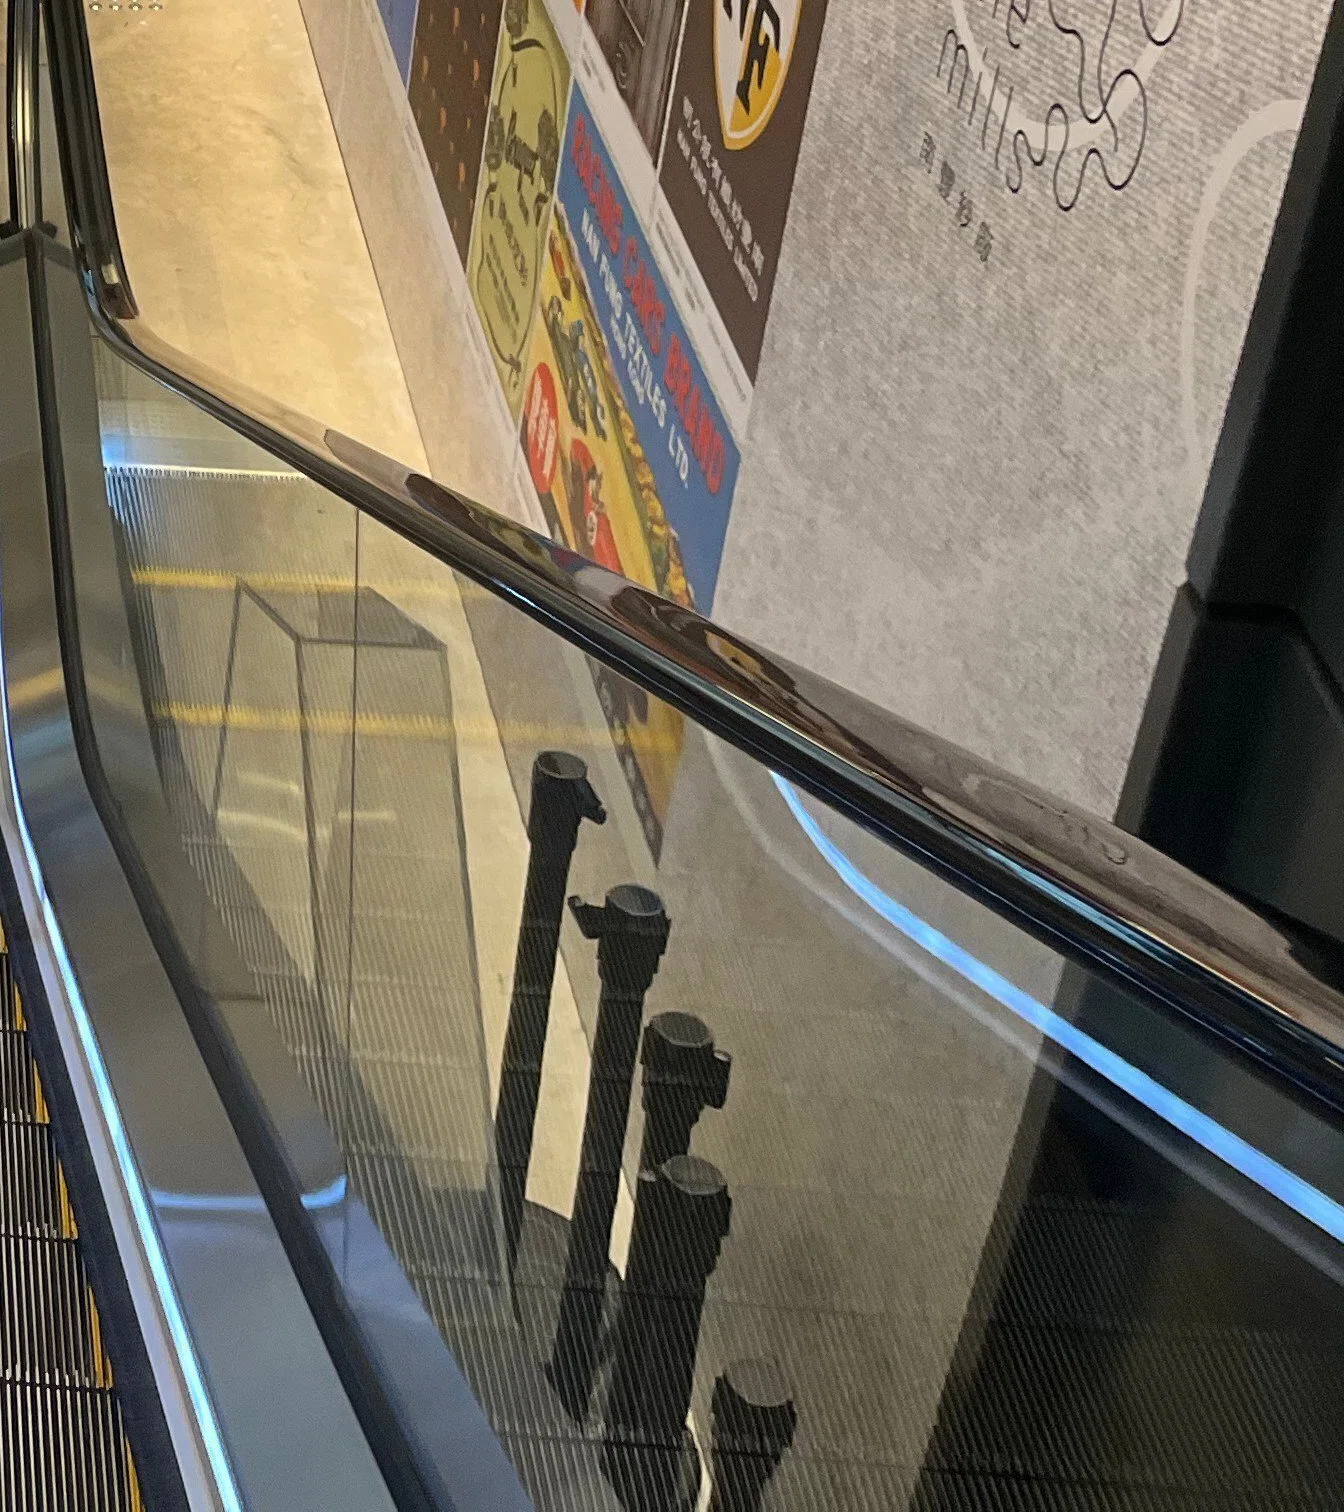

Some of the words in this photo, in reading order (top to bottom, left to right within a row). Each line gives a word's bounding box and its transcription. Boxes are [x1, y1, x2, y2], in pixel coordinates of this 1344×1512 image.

[580, 207, 601, 264] NAN
[598, 253, 623, 319] FUNG
[624, 310, 667, 428] TEXTILES
